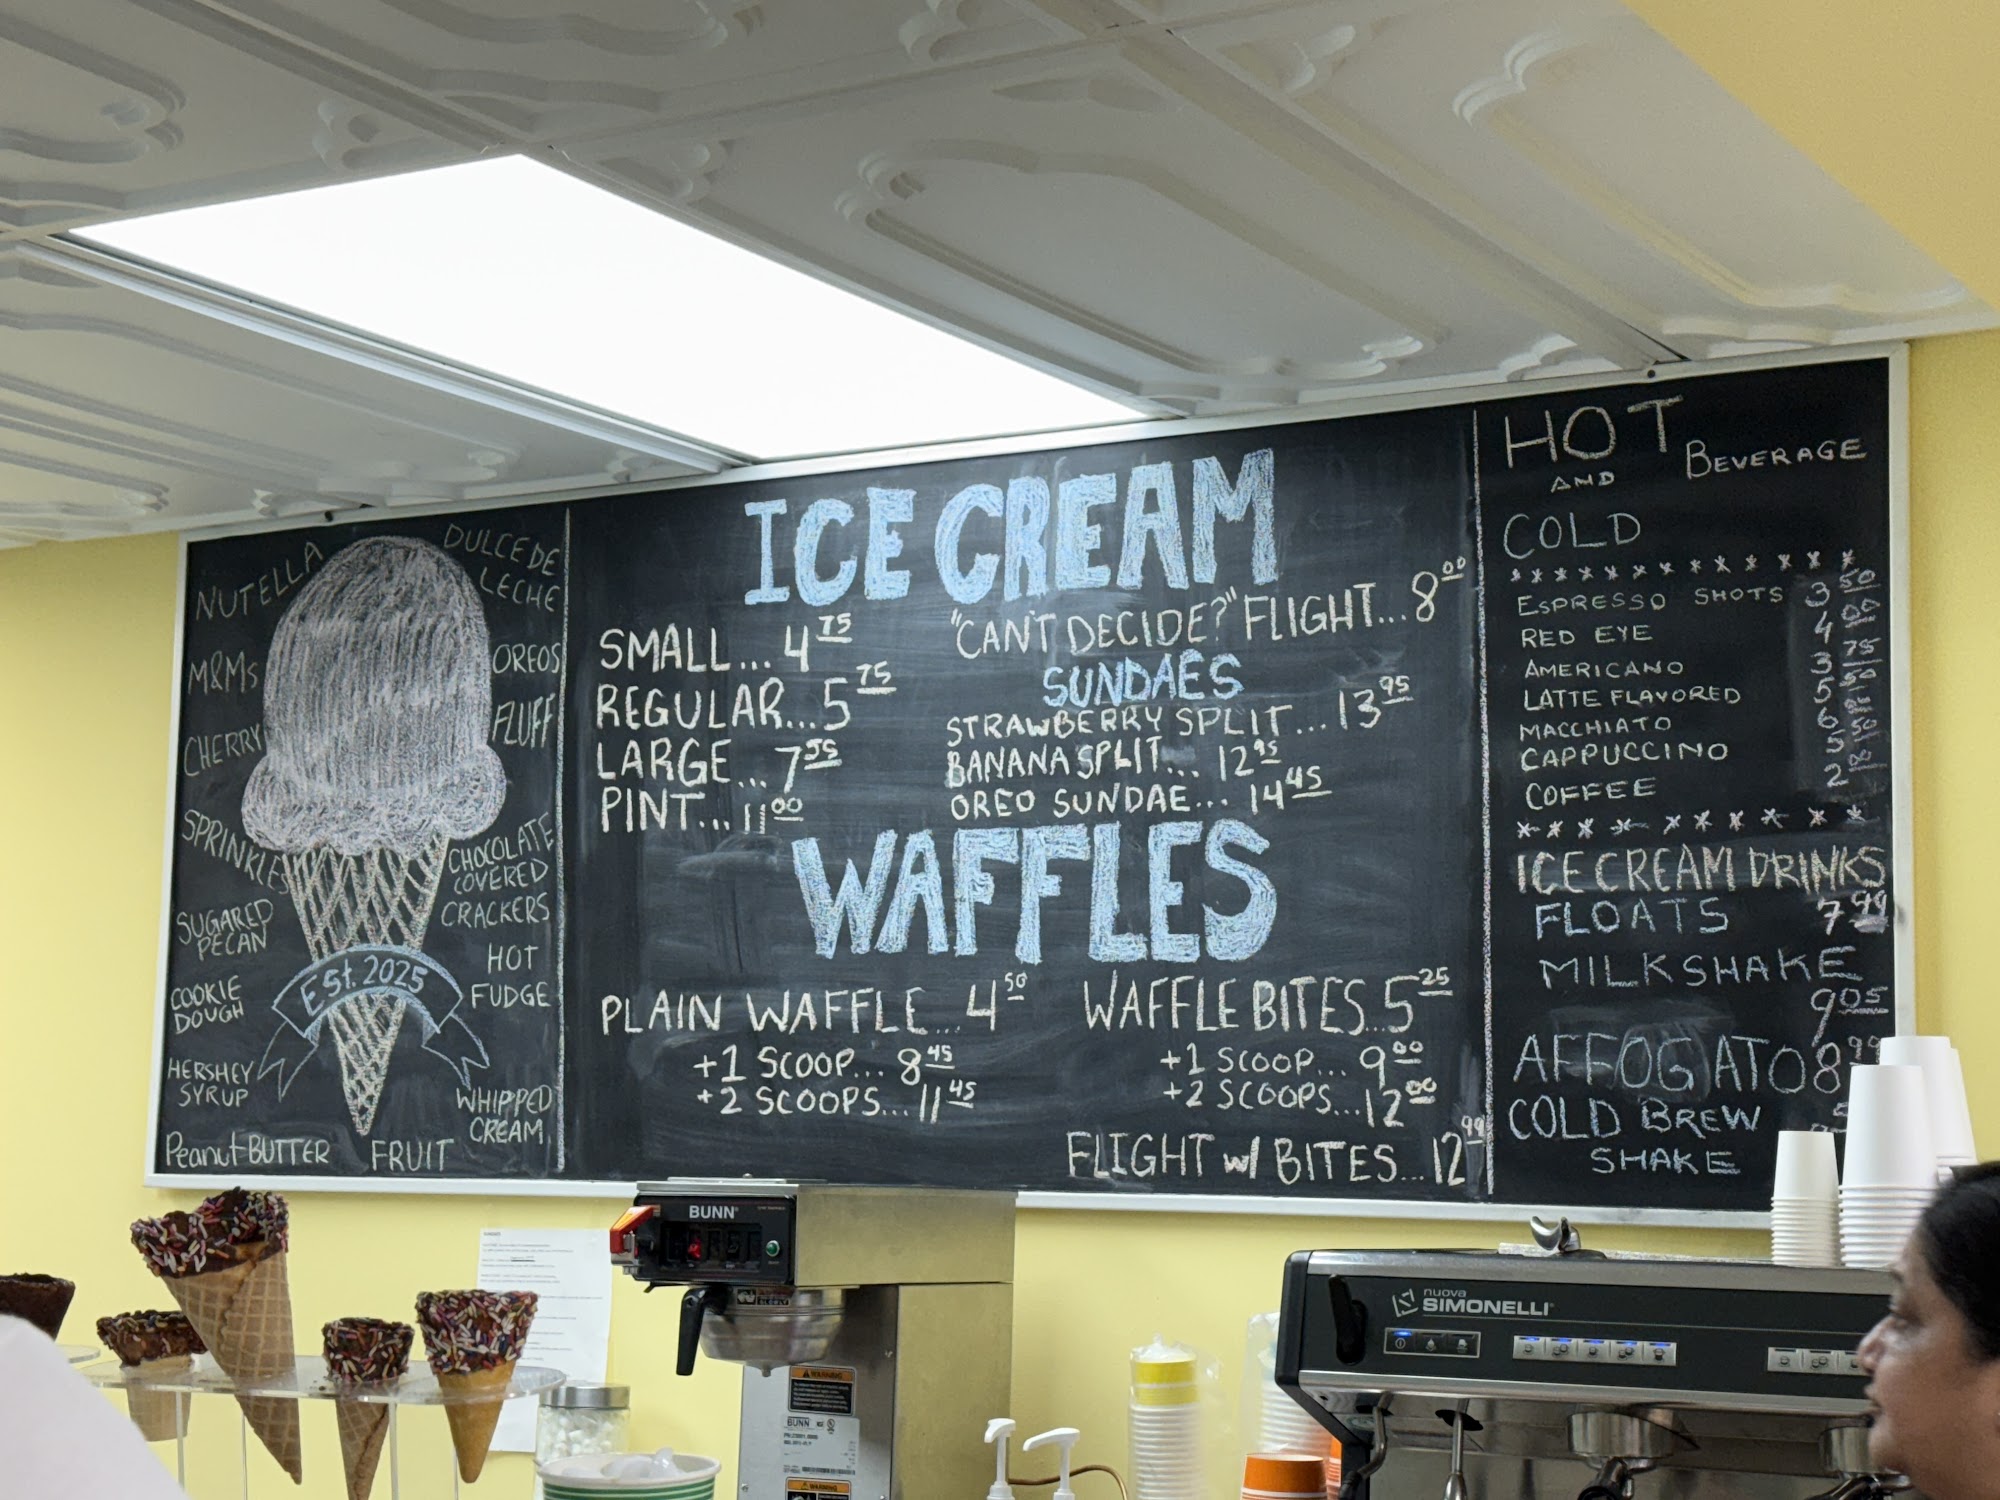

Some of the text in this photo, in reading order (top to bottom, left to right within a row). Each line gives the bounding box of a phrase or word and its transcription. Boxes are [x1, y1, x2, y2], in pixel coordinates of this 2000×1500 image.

[1505, 394, 1684, 469] HOT
[744, 448, 1279, 607] ICE CREAM
[1503, 511, 1642, 561] COLD
[444, 523, 560, 576] DULCE DE
[196, 541, 325, 620] NUTELLA
[480, 566, 561, 613] LECHE
[1517, 592, 1667, 617] ESPRESSO
[1694, 586, 1784, 606] SHOTS
[1521, 627, 1575, 648] RED
[1595, 624, 1654, 644] EYE
[188, 651, 258, 695] M&Ms
[492, 643, 561, 675] OREOS
[1042, 647, 1245, 708] SUNDAES
[1524, 659, 1684, 679] AMERICANO
[1523, 688, 1603, 712] LATTE
[1610, 684, 1742, 706] FLAVORED
[492, 693, 556, 749] FLUFF
[946, 705, 1163, 748] STRAWBERRY
[1519, 716, 1672, 743] MACCHIATO
[184, 724, 262, 777] CHERRY
[946, 743, 1070, 789] BANANA
[1520, 741, 1729, 772] CAPPUCCINO
[950, 787, 1036, 821] OREO
[1525, 776, 1657, 812] COFFEE
[181, 809, 290, 895] SPRINKLES
[448, 811, 554, 874] CHOCOLATE
[453, 857, 549, 895] COVERED
[1517, 843, 1885, 895] ICE CREAM DRINKS
[441, 892, 550, 929] CRACKERS
[792, 818, 1277, 965] WAFFLES
[177, 899, 273, 944] SUGARED
[1535, 896, 1729, 940] FLOATS
[197, 931, 267, 960] PECAN
[487, 942, 538, 974] HOT
[363, 954, 428, 993] 2025
[171, 975, 242, 1011] COOKIE
[472, 982, 552, 1008] FUDGE
[1084, 969, 1239, 1032] WAFFLE
[175, 1001, 243, 1034] DOUGH
[601, 989, 722, 1036] PLAIN
[167, 1057, 254, 1084] HERSHEY
[1513, 1033, 1806, 1094] AFFOGATO
[178, 1081, 248, 1107] SYRUP
[456, 1084, 552, 1114] WHIPPED
[469, 1117, 543, 1144] CREAM
[1509, 1094, 1622, 1141] COLD
[1641, 1096, 1762, 1139] BREW
[166, 1131, 330, 1169] Peanut BUTTER
[371, 1138, 454, 1171] FRUIT
[1066, 1131, 1216, 1180] FLIGHT
[1590, 1148, 1741, 1175] SHAKE
[688, 1205, 736, 1219] BUNN
[1422, 1297, 1550, 1317] SIMONELLI
[1423, 1287, 1467, 1298] nuova
